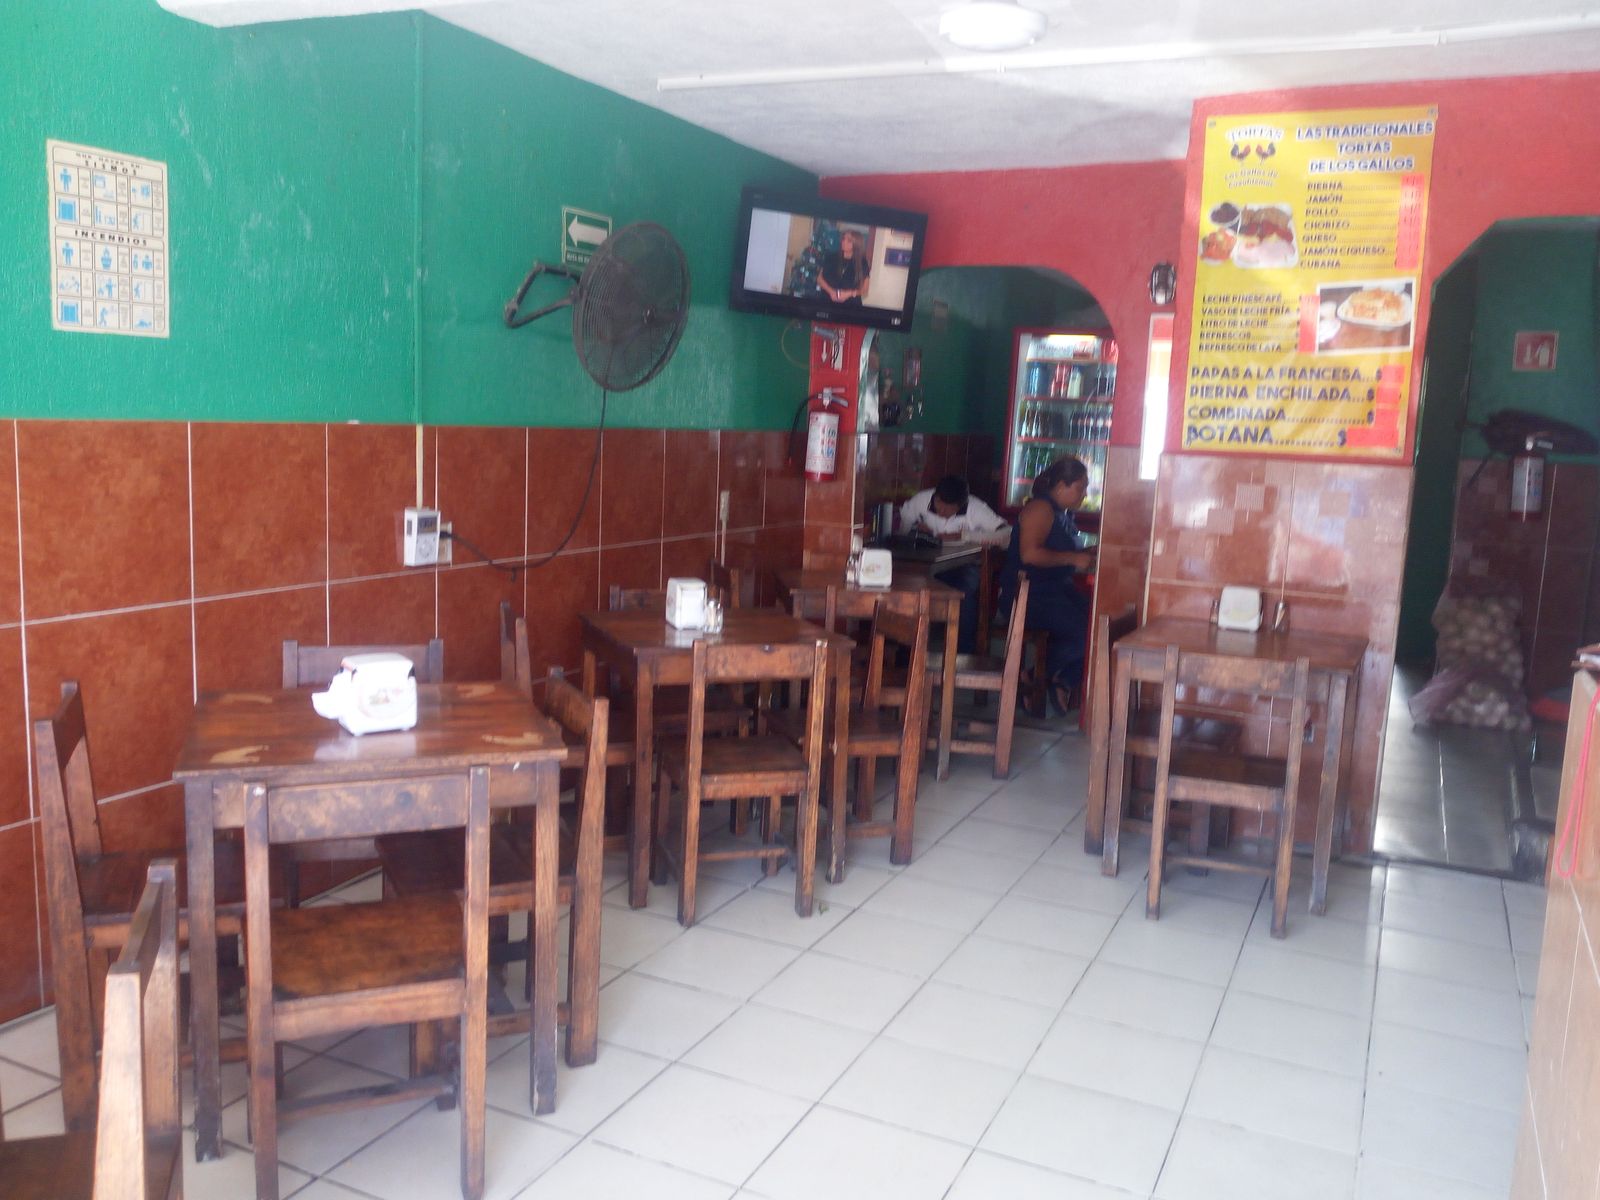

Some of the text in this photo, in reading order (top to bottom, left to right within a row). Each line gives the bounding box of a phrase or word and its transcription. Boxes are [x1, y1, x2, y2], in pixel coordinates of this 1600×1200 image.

[1297, 122, 1433, 140] LAS TRADICIONALES
[1338, 142, 1391, 155] TORTAS
[85, 160, 137, 176] SISMOS
[1310, 158, 1414, 173] DE LOS GALLOS
[1307, 181, 1343, 192] PIERNA
[1305, 208, 1338, 217] POLLO
[1304, 220, 1350, 230] CHORIZO
[75, 230, 147, 246] INCENDIOS
[1302, 233, 1337, 243] QUESO
[1191, 366, 1240, 379] PAPAS
[1243, 367, 1254, 380] A
[1256, 367, 1275, 380] LA
[1278, 367, 1362, 382] FRANCESA
[1190, 386, 1248, 399] PIERNA
[1256, 386, 1351, 401] ENCHILADA
[1187, 407, 1287, 422] COMBINADA
[1186, 425, 1274, 446] BOTANA
